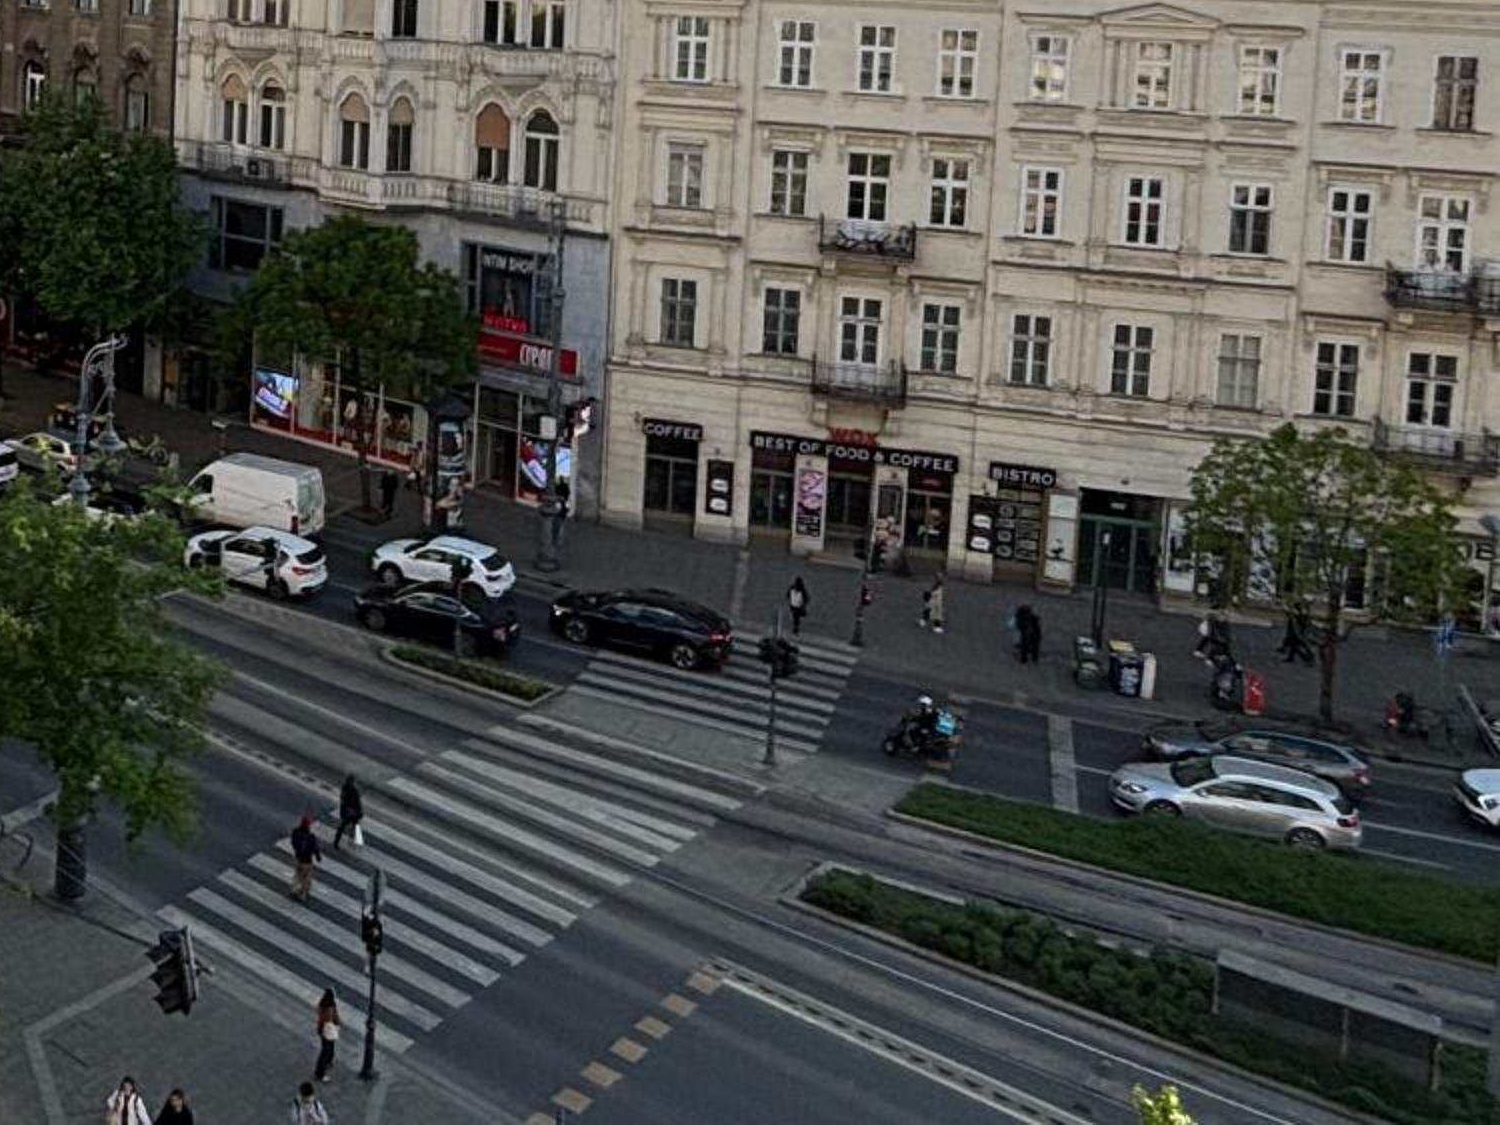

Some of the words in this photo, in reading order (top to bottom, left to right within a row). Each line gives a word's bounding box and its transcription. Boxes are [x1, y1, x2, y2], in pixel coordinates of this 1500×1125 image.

[644, 424, 701, 441] COFFEE
[754, 435, 794, 452] BEST
[799, 441, 821, 454] OF
[825, 444, 870, 462] FOOD
[889, 452, 955, 473] COFFEE
[992, 466, 1055, 487] BISTRO
